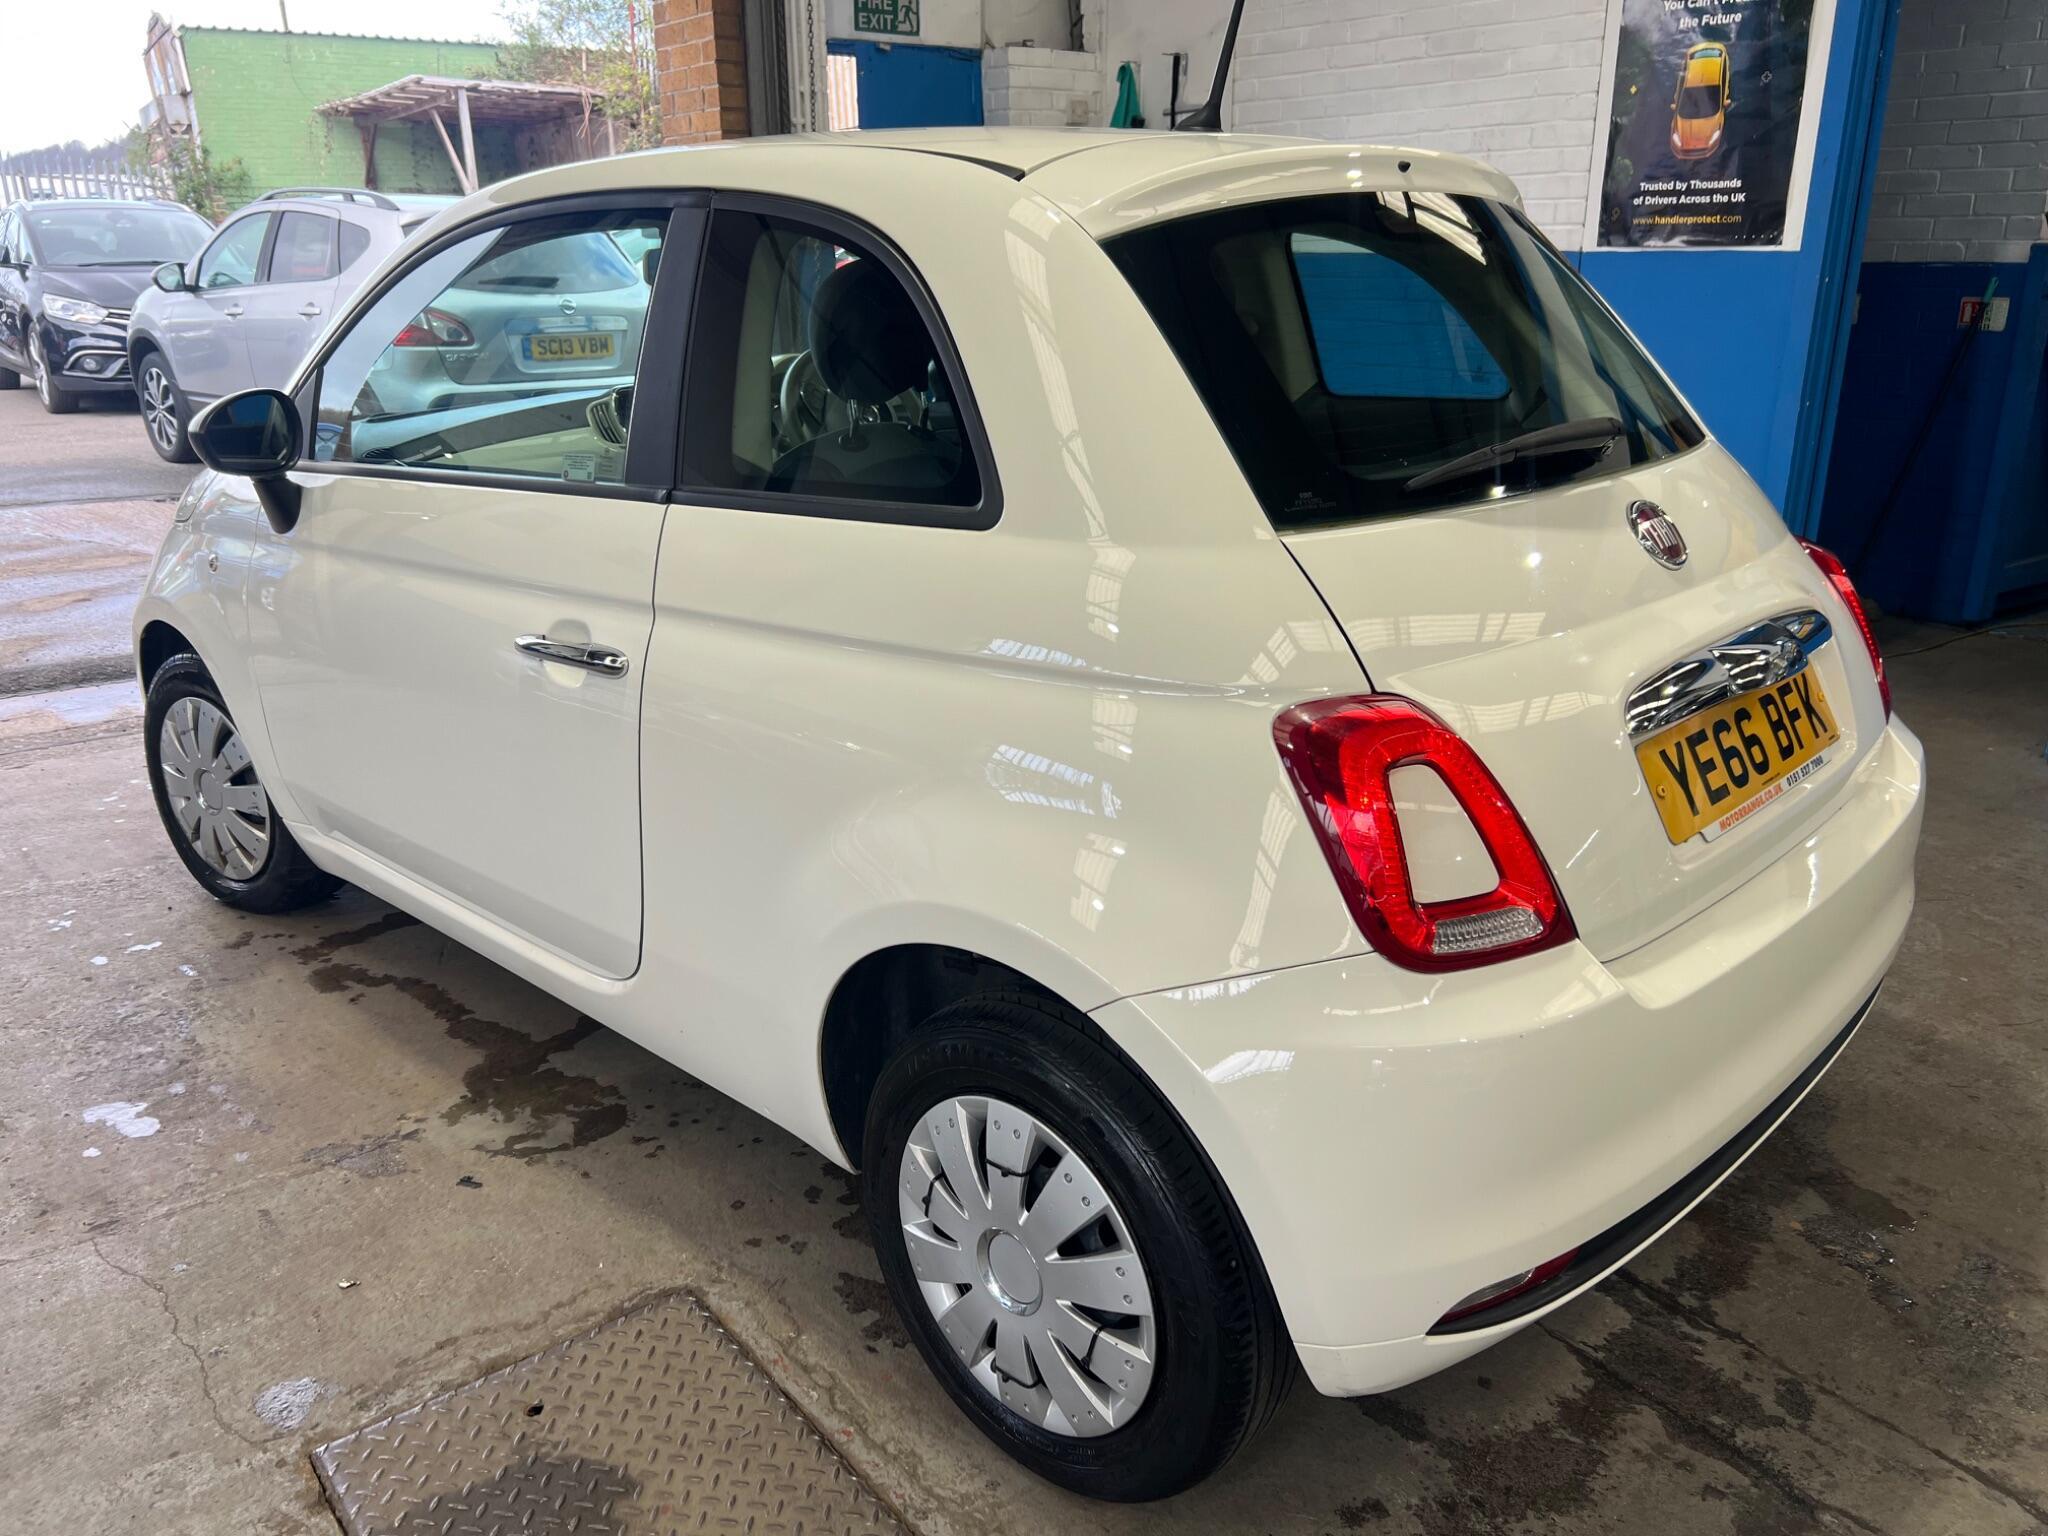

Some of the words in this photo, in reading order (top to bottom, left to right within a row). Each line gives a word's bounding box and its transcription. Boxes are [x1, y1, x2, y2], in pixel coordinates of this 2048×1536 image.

[1663, 0, 1684, 11] You
[858, 13, 894, 30] EXIT
[1679, 16, 1699, 28] the
[1701, 13, 1742, 26] Future
[1640, 181, 1674, 191] Trusted
[1675, 180, 1687, 191] by
[1689, 178, 1742, 189] Thousands
[1633, 196, 1643, 205] of
[1645, 195, 1677, 205] Drivers
[1679, 194, 1710, 204] Across
[1712, 194, 1728, 203] the
[1730, 192, 1746, 202] UK
[1632, 214, 1742, 225] www.handlerprotect.com
[537, 338, 573, 356] SC13
[1659, 707, 1770, 817] YE66
[1758, 673, 1828, 761] BFK
